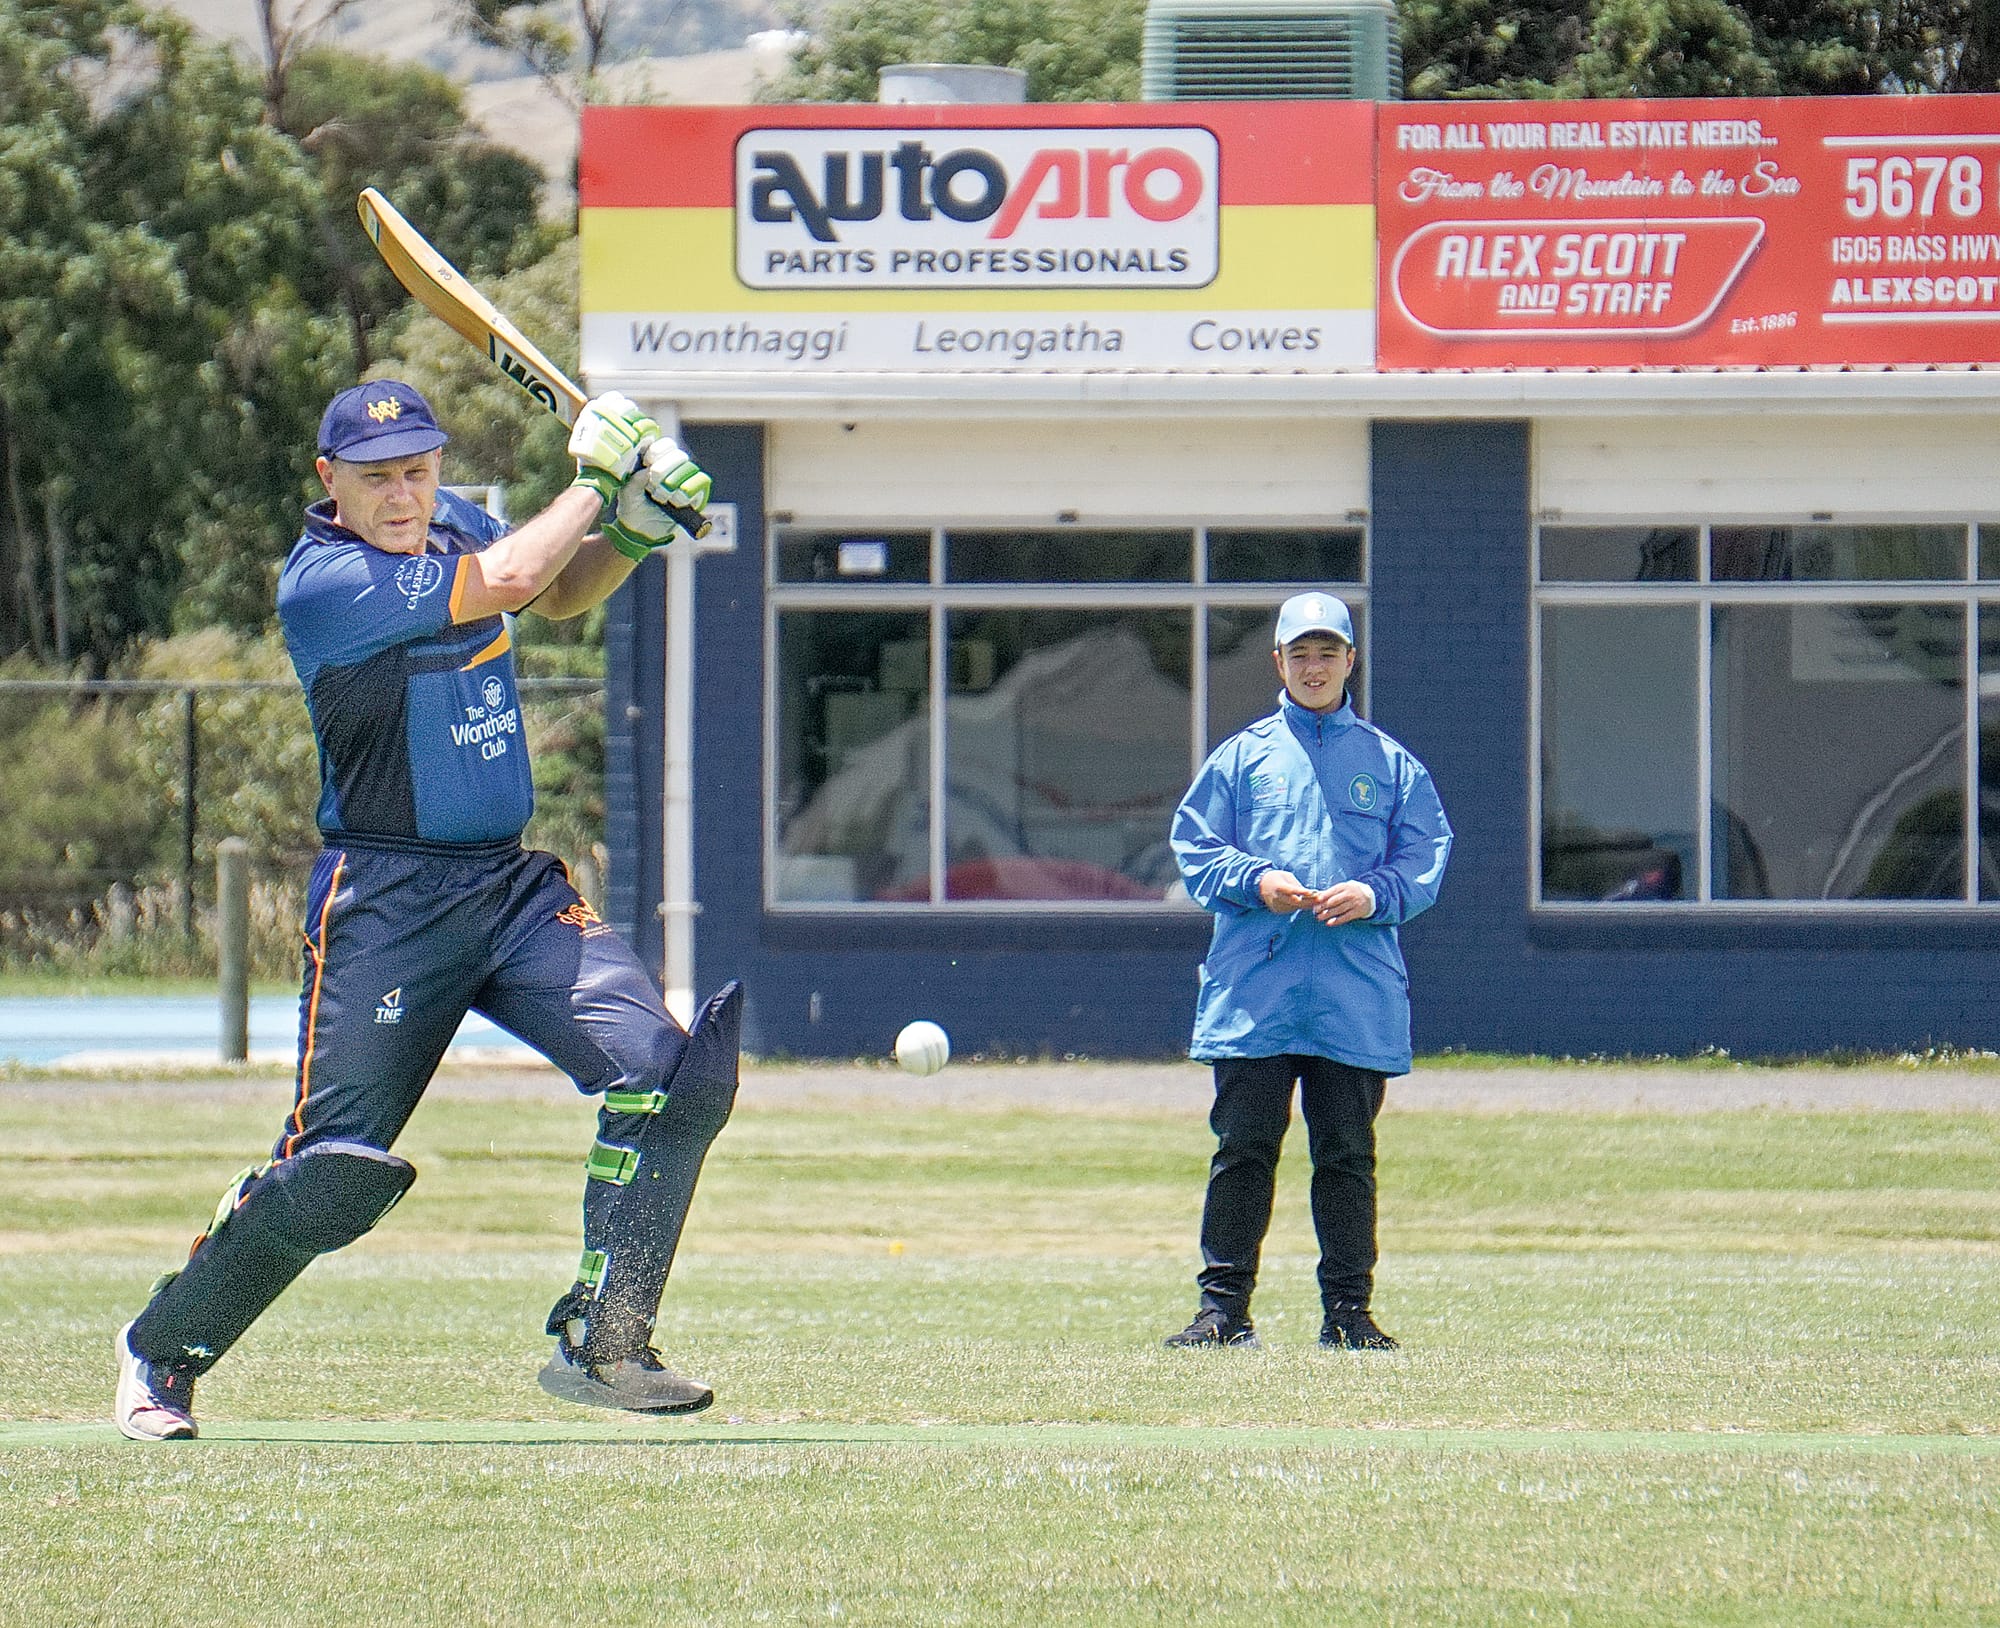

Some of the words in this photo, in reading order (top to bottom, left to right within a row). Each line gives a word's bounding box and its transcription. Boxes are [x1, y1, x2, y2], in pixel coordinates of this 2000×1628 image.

[1398, 123, 1441, 149] FOR
[1444, 123, 1485, 149] ALL
[1487, 122, 1546, 148] YOUR
[1550, 121, 1606, 147] REAL
[1609, 120, 1688, 146] ESTATE
[1400, 166, 1485, 201] From
[1490, 171, 1525, 198] the
[1529, 163, 1664, 200] Mountain
[1669, 169, 1695, 195] to
[1701, 169, 1736, 195] the
[1741, 161, 1801, 196] Sea
[1846, 155, 1983, 217] 5678
[767, 250, 876, 273] PARTS
[891, 248, 1189, 272] PROFESSIONALS
[1436, 235, 1547, 277] ALEX
[1552, 233, 1687, 277] SCOTT
[1832, 236, 1882, 263] 1505
[1887, 235, 1947, 261] BASS
[1499, 284, 1560, 307] AND
[1566, 282, 1673, 314] STAFF
[1832, 275, 2000, 303] ALEXSCOT
[630, 321, 849, 360] Wonthaggi
[913, 319, 1125, 360] Leongatha
[1190, 319, 1322, 351] Cowes
[465, 706, 485, 722] The
[481, 737, 506, 760] Club
[375, 1007, 403, 1020] TNF
